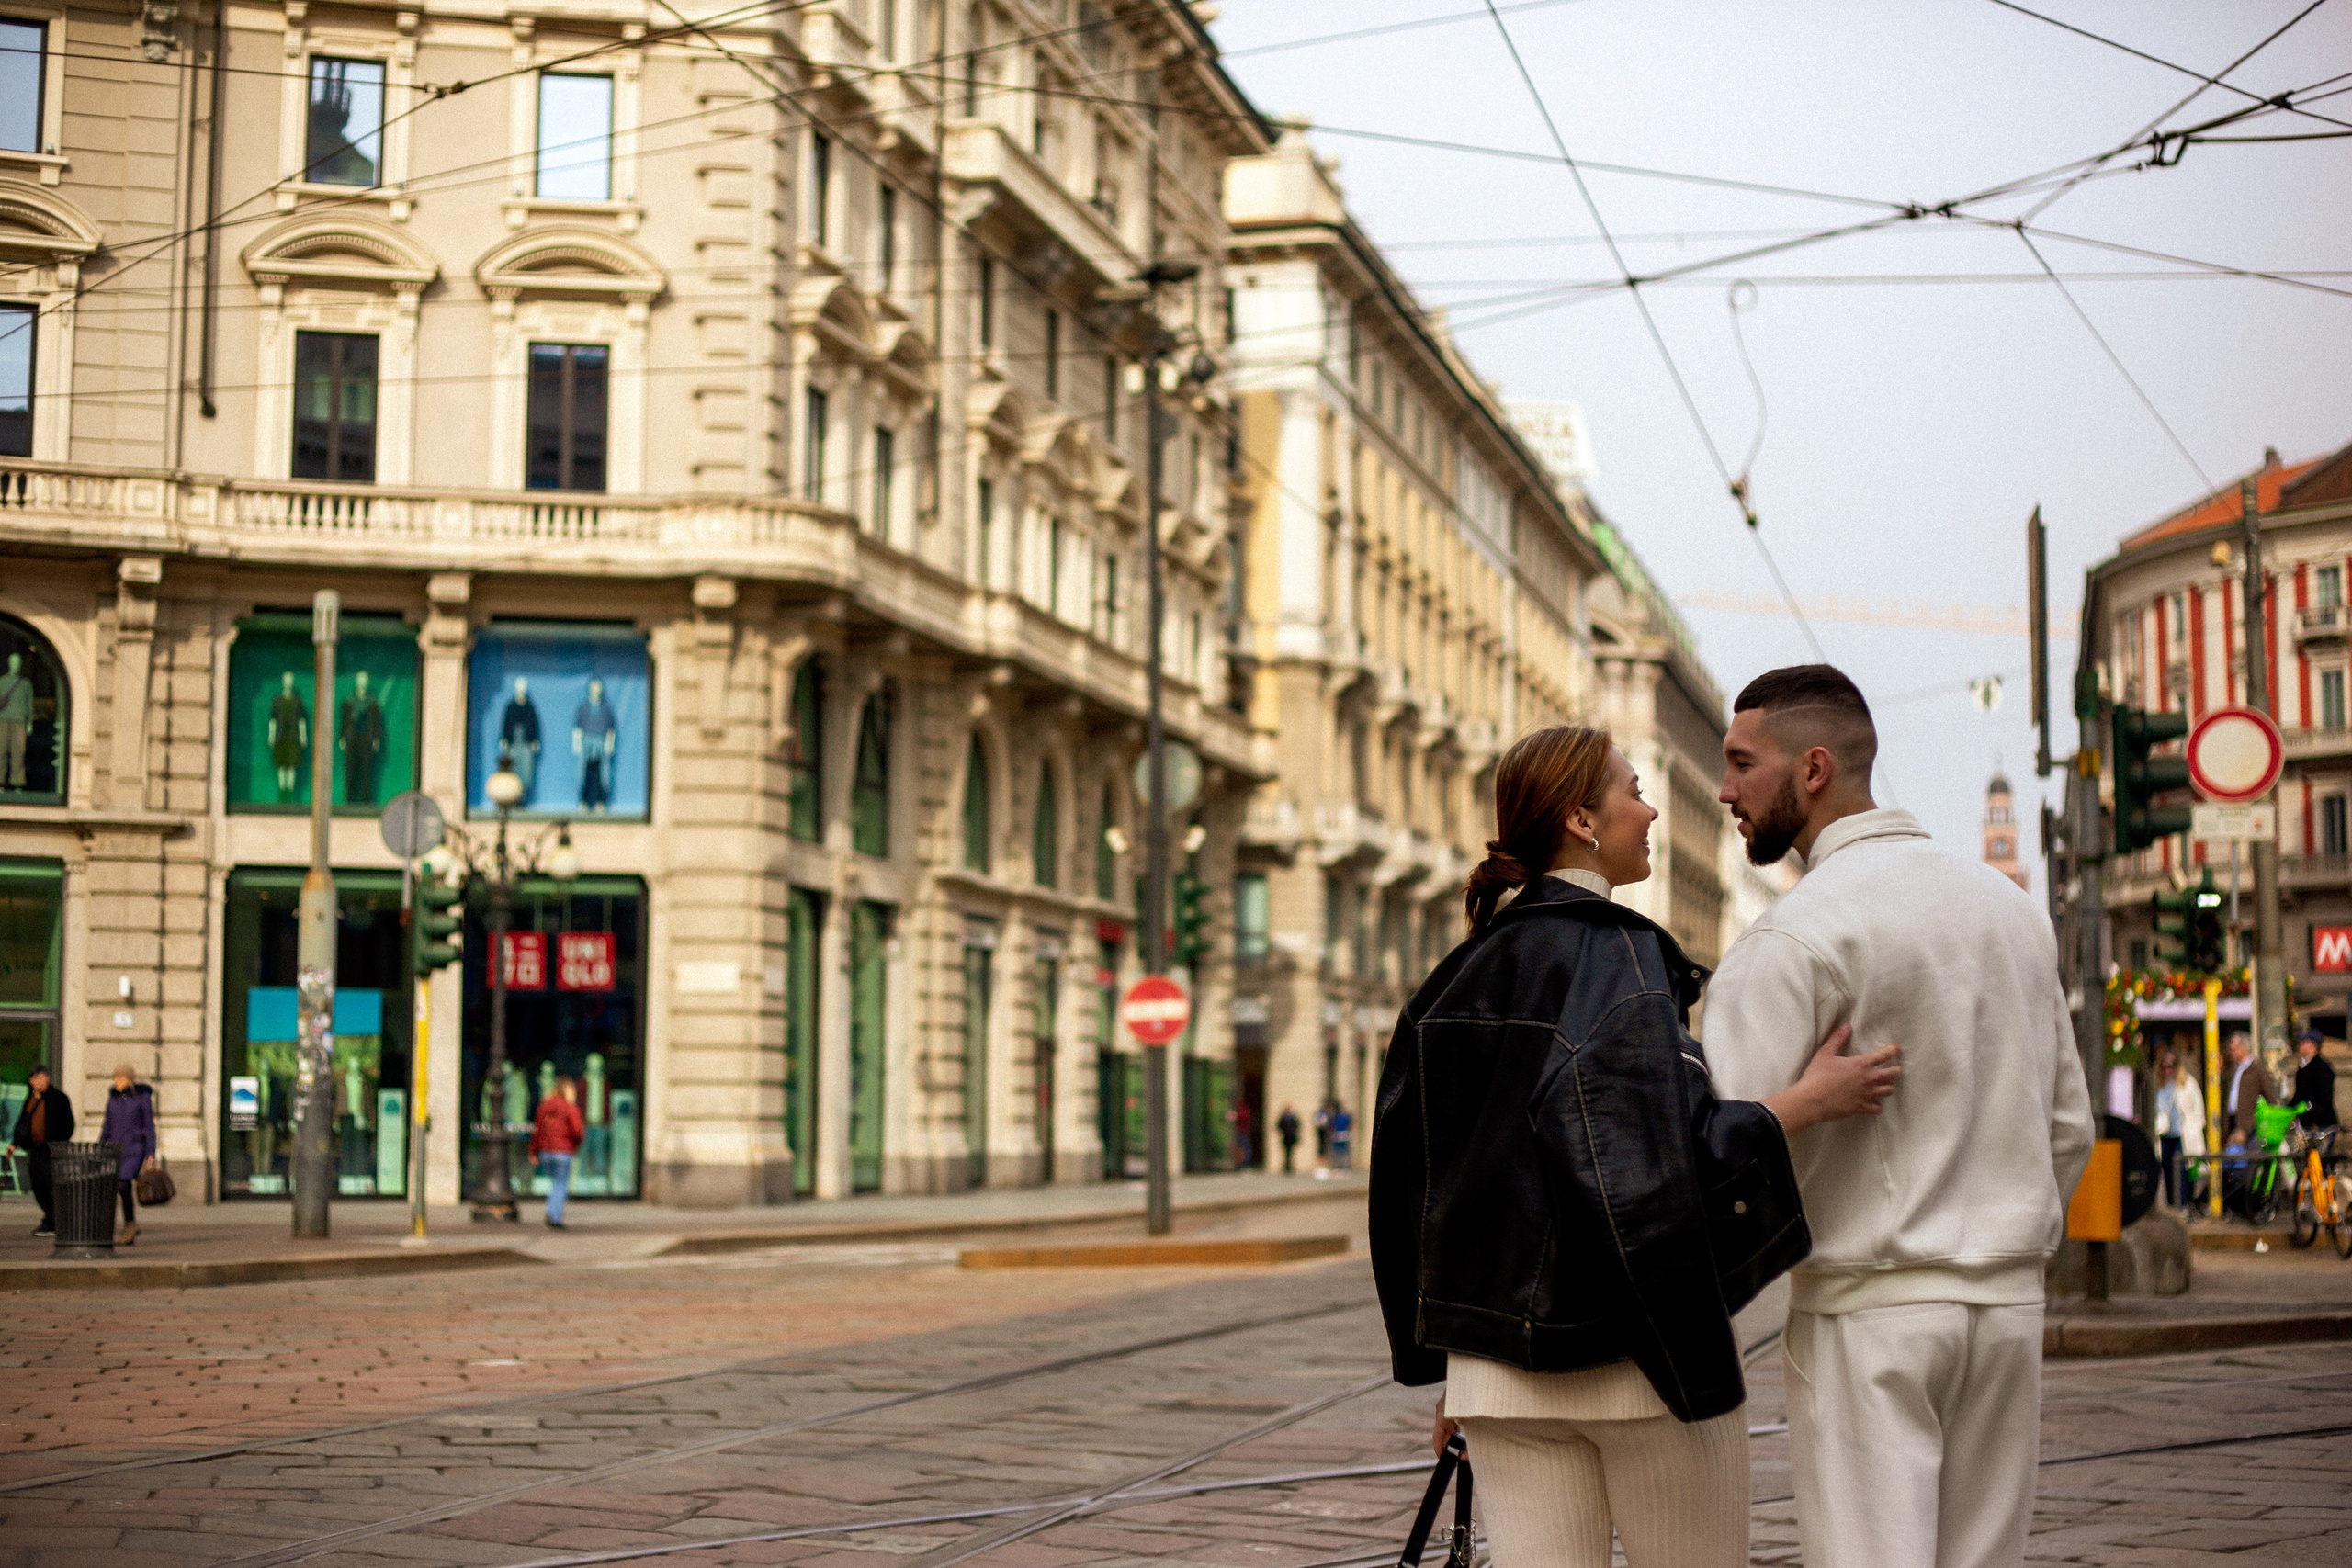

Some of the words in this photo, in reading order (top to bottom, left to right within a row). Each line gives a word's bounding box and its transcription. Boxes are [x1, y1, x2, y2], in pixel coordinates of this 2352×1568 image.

[562, 935, 607, 960] UNI
[2315, 931, 2352, 966] M
[561, 960, 612, 987] QLO
